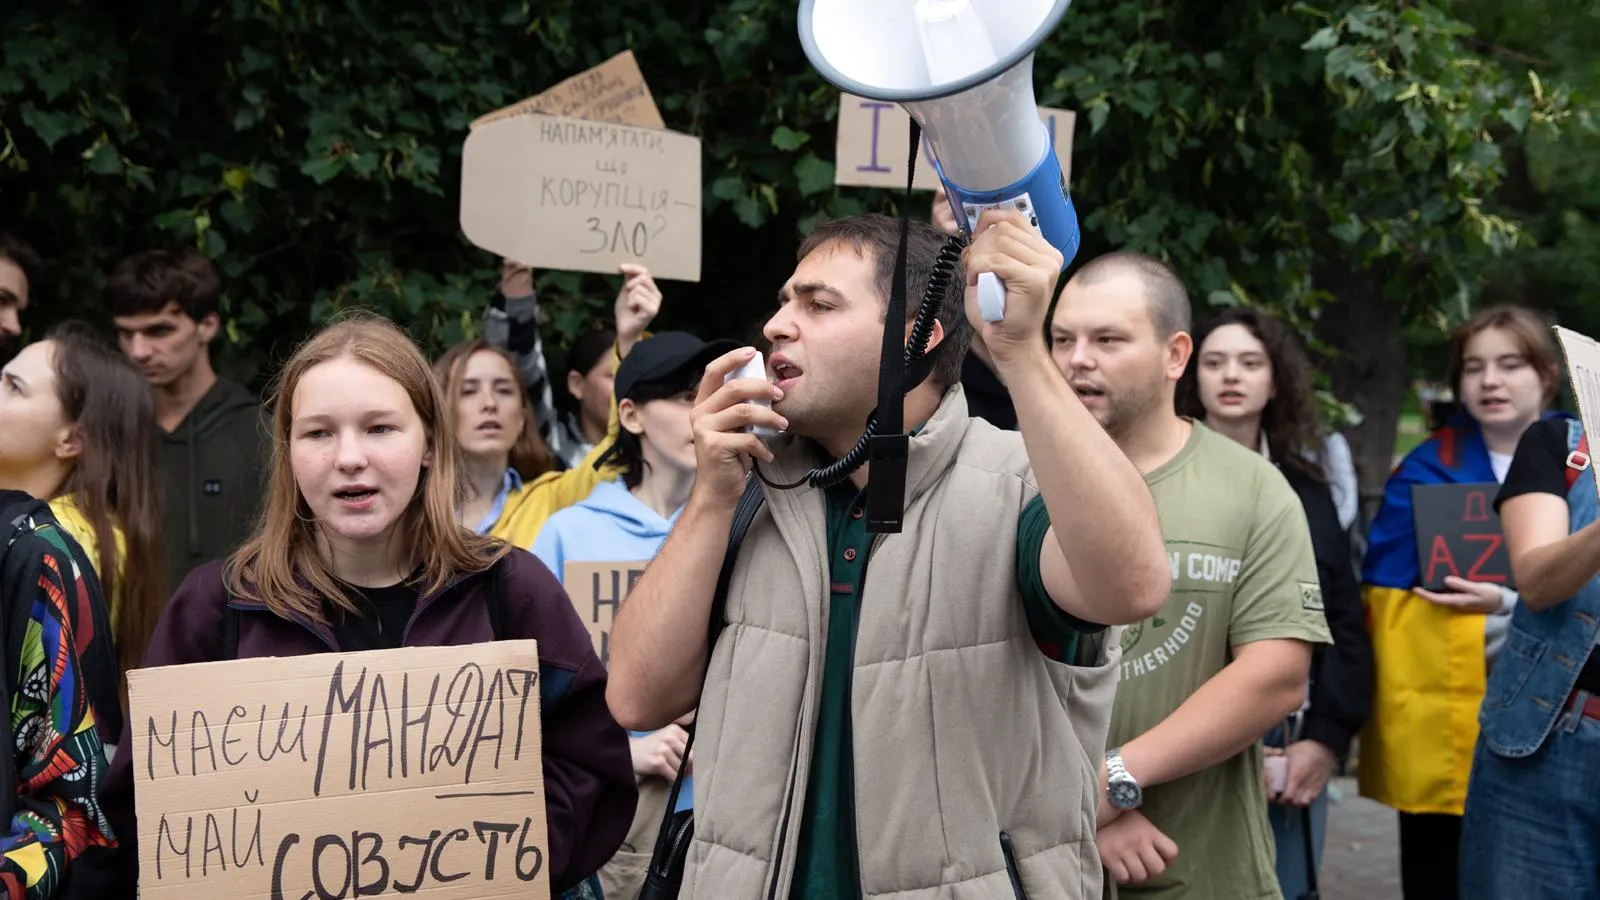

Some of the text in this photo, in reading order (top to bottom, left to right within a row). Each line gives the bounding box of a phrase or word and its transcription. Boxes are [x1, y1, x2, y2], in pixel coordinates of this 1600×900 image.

[579, 213, 667, 257] ЗЛО?
[1187, 552, 1242, 583] COMP
[1116, 601, 1203, 683] THERHOOD
[313, 660, 538, 797] МАНДАТ
[156, 788, 264, 880] МАЙ
